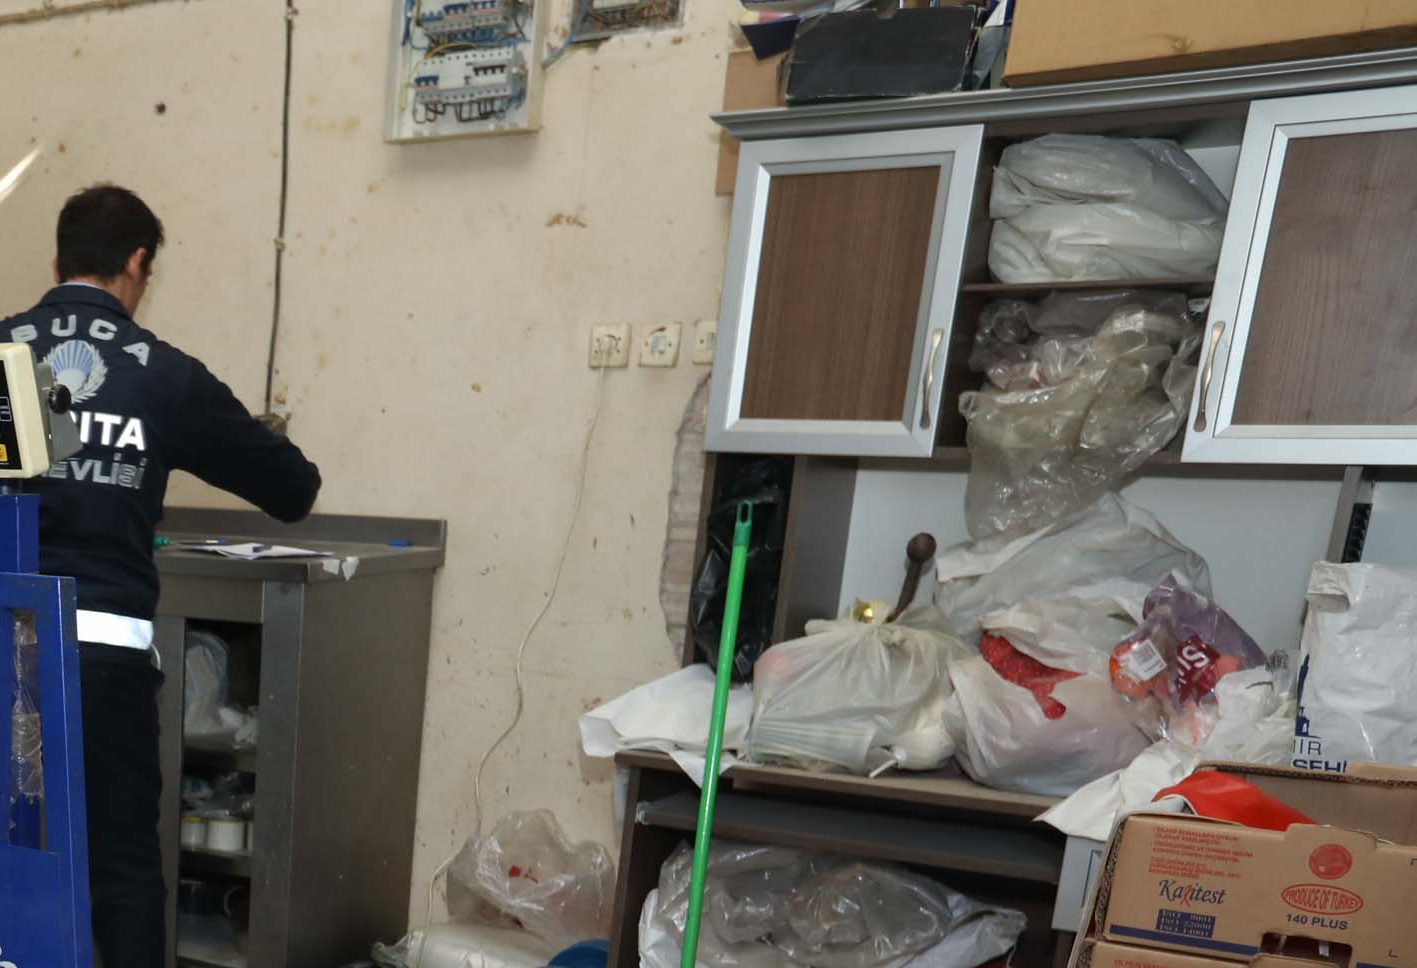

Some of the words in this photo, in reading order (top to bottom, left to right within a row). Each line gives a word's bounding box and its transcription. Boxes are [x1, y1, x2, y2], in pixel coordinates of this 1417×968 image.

[10, 314, 150, 367] BUCA
[70, 410, 145, 451] ITA
[1286, 913, 1308, 925] 140
[1311, 916, 1349, 930] PLUS
